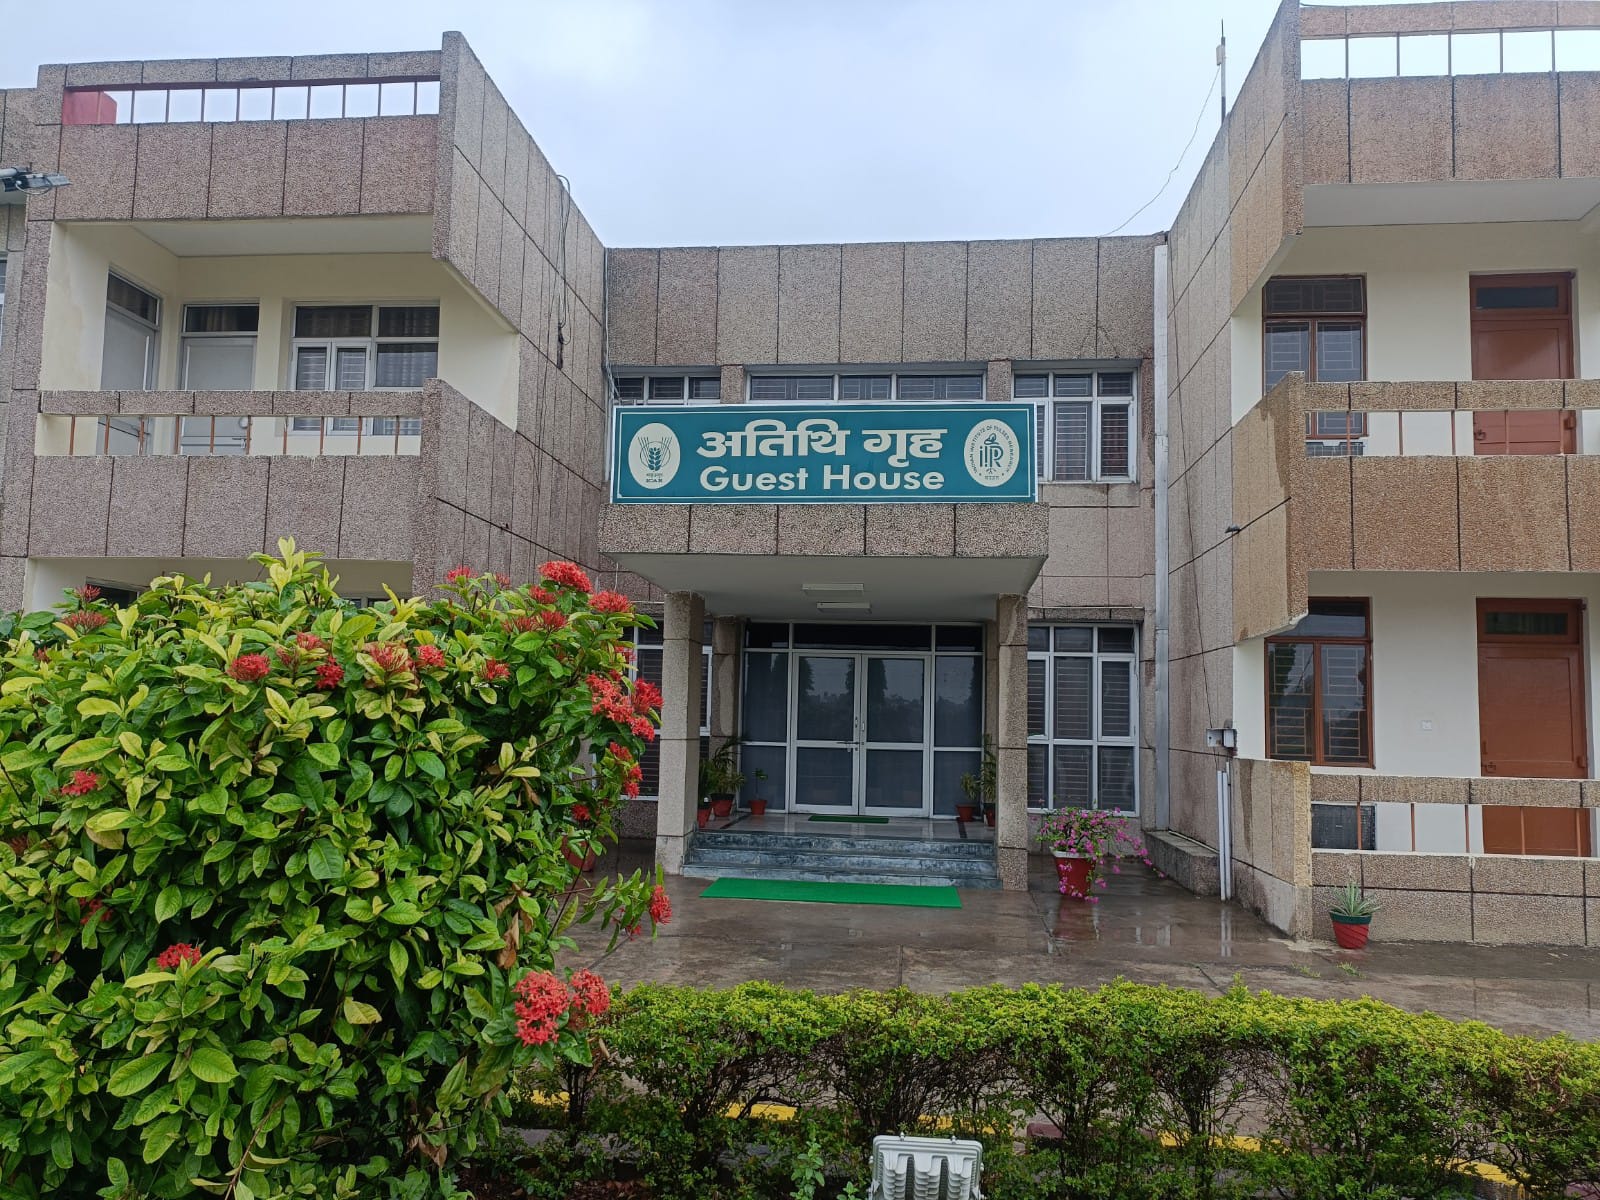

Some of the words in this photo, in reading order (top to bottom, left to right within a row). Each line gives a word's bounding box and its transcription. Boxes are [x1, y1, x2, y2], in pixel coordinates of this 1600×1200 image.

[696, 418, 851, 458] अतिथि
[861, 428, 948, 468] गृह
[700, 465, 809, 492] Guest
[823, 464, 945, 491] House
